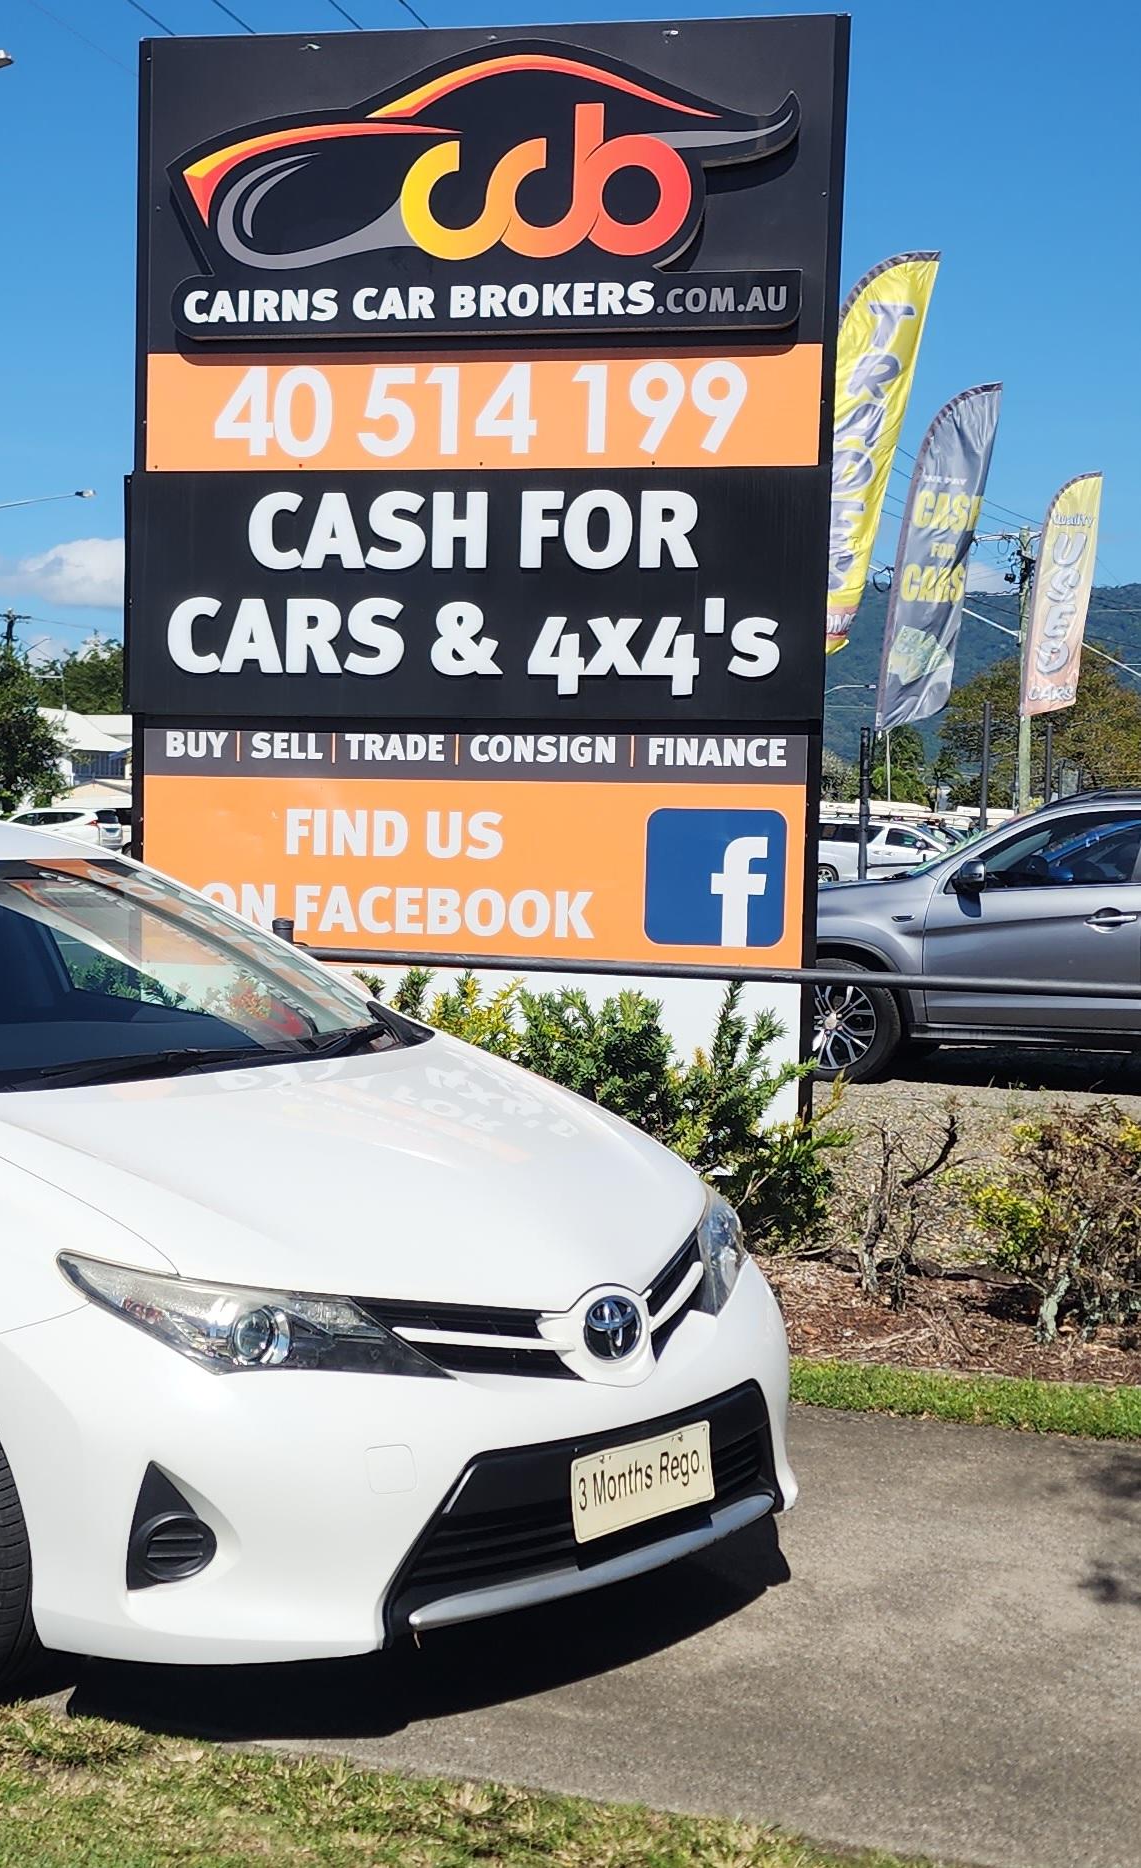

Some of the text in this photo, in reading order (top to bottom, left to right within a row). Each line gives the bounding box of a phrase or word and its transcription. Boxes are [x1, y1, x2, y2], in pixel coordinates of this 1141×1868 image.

[184, 288, 339, 324] CAIRNS
[353, 286, 436, 321] CAR
[214, 358, 748, 458] 40 514 199
[247, 489, 699, 570] CASH FOR
[1037, 532, 1088, 676] USED
[167, 597, 405, 675] CARS
[431, 601, 504, 676] &
[1027, 682, 1076, 702] CARS
[165, 730, 787, 768] BUY SELL TRADE CONSIGN FINANCE
[286, 807, 504, 860] FIND US
[199, 882, 276, 934] ON
[293, 884, 595, 939] FACEBOOK
[578, 1448, 706, 1511] 3 Months Rego.
